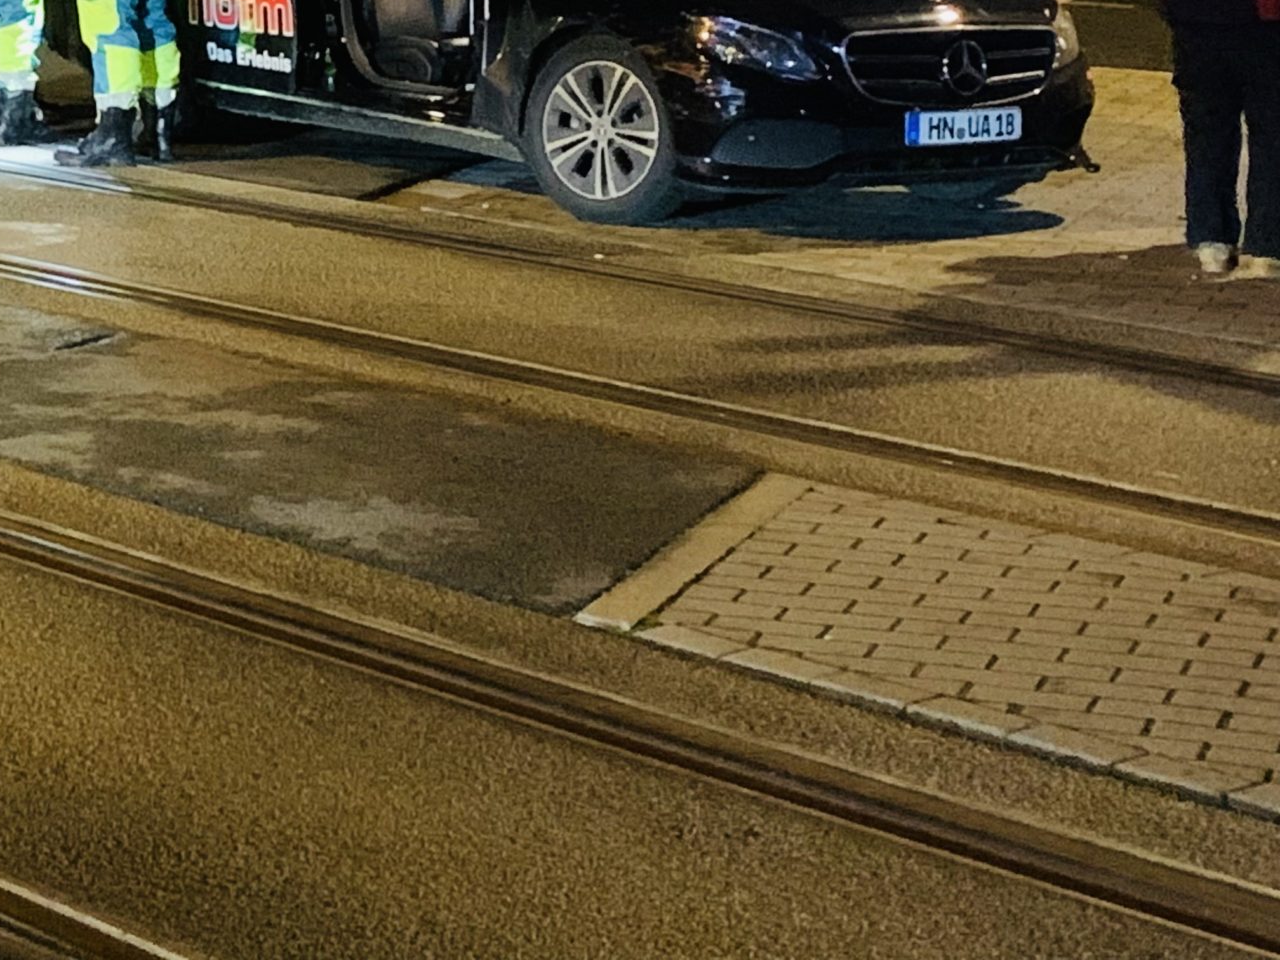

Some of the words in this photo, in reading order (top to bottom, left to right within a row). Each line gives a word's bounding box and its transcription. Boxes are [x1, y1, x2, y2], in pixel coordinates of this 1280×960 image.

[206, 41, 233, 64] Das
[235, 44, 293, 74] Erlebnis
[928, 116, 955, 140] HN
